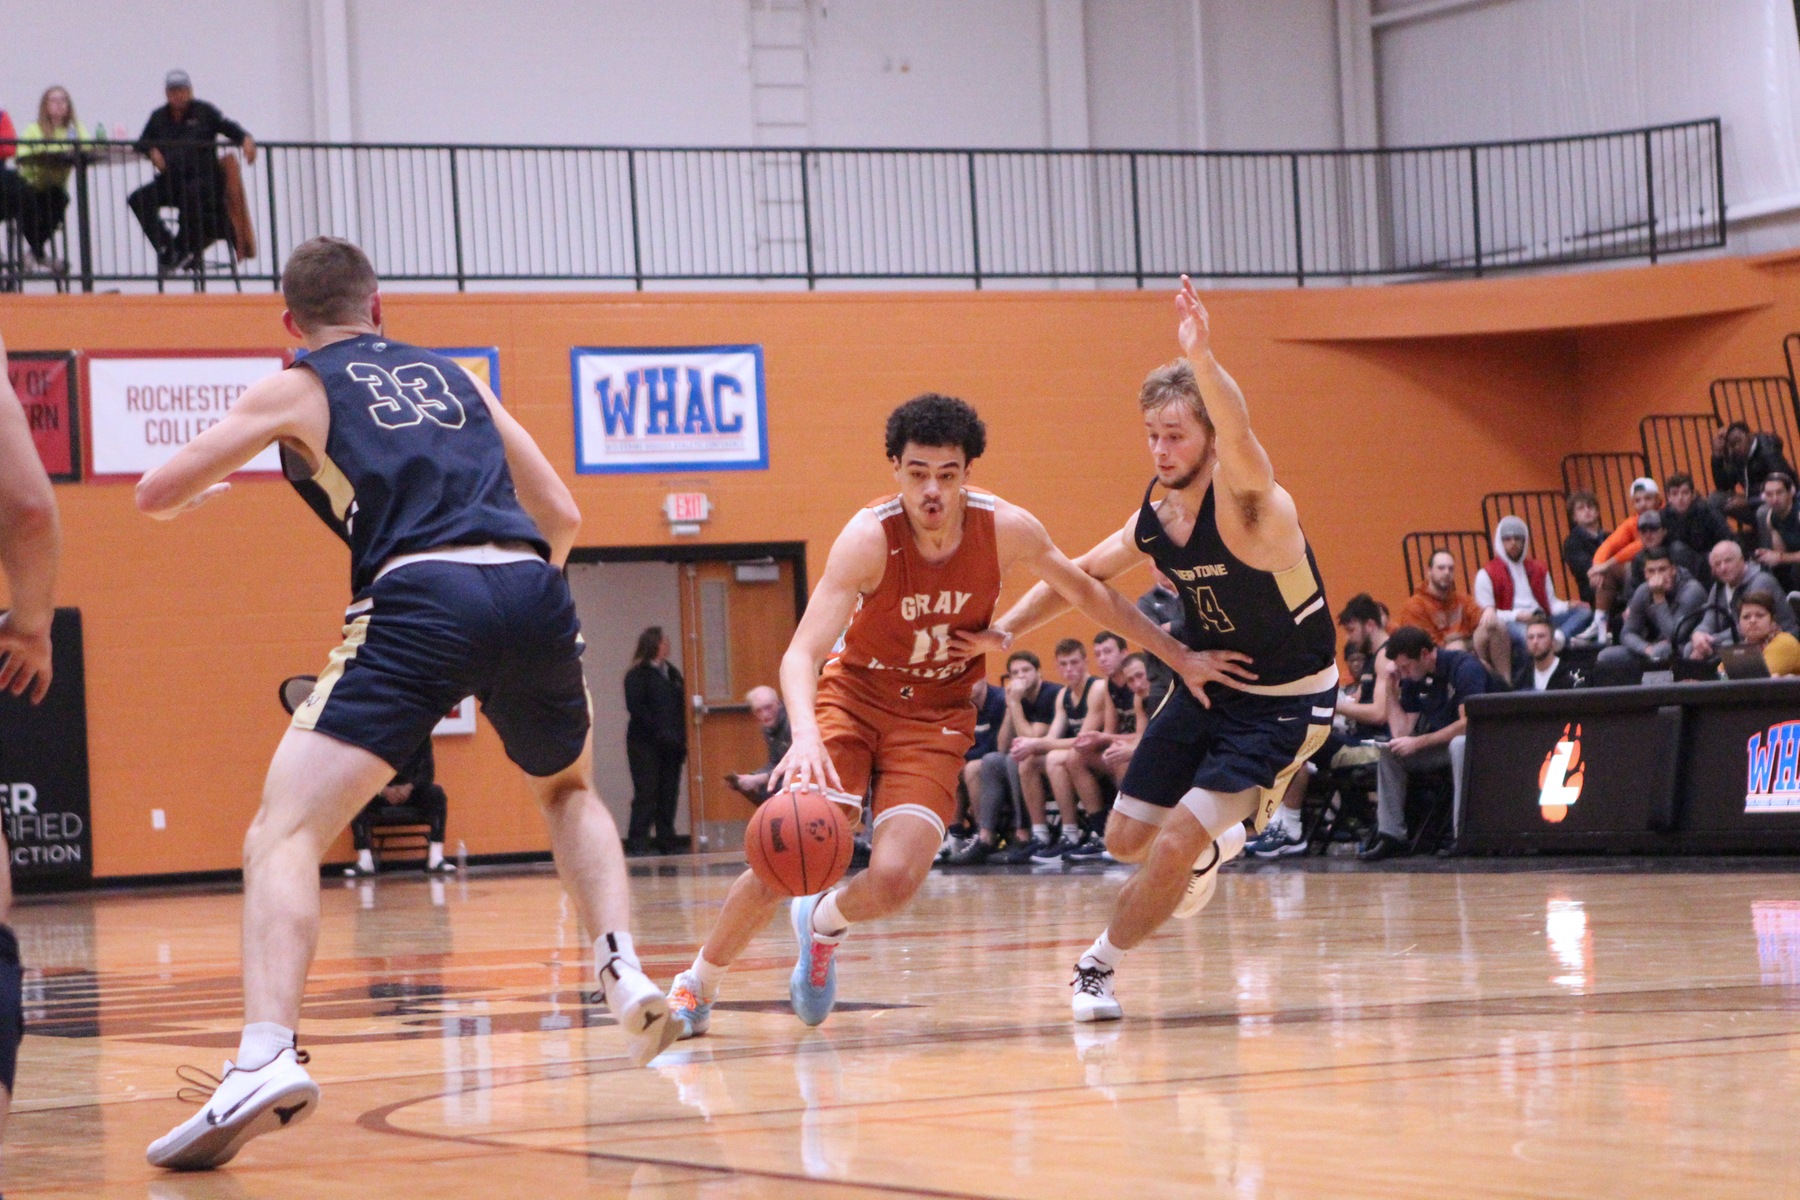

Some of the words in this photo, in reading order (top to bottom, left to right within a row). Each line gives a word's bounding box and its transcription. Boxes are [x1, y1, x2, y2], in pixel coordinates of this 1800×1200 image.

[346, 362, 466, 429] 33
[594, 366, 746, 437] WHAC
[675, 495, 702, 520] EXIT
[901, 590, 973, 621] GRAY
[908, 624, 951, 665] 11
[1747, 719, 1800, 793] WH
[7, 811, 83, 841] IFIED
[10, 844, 81, 866] CTION
